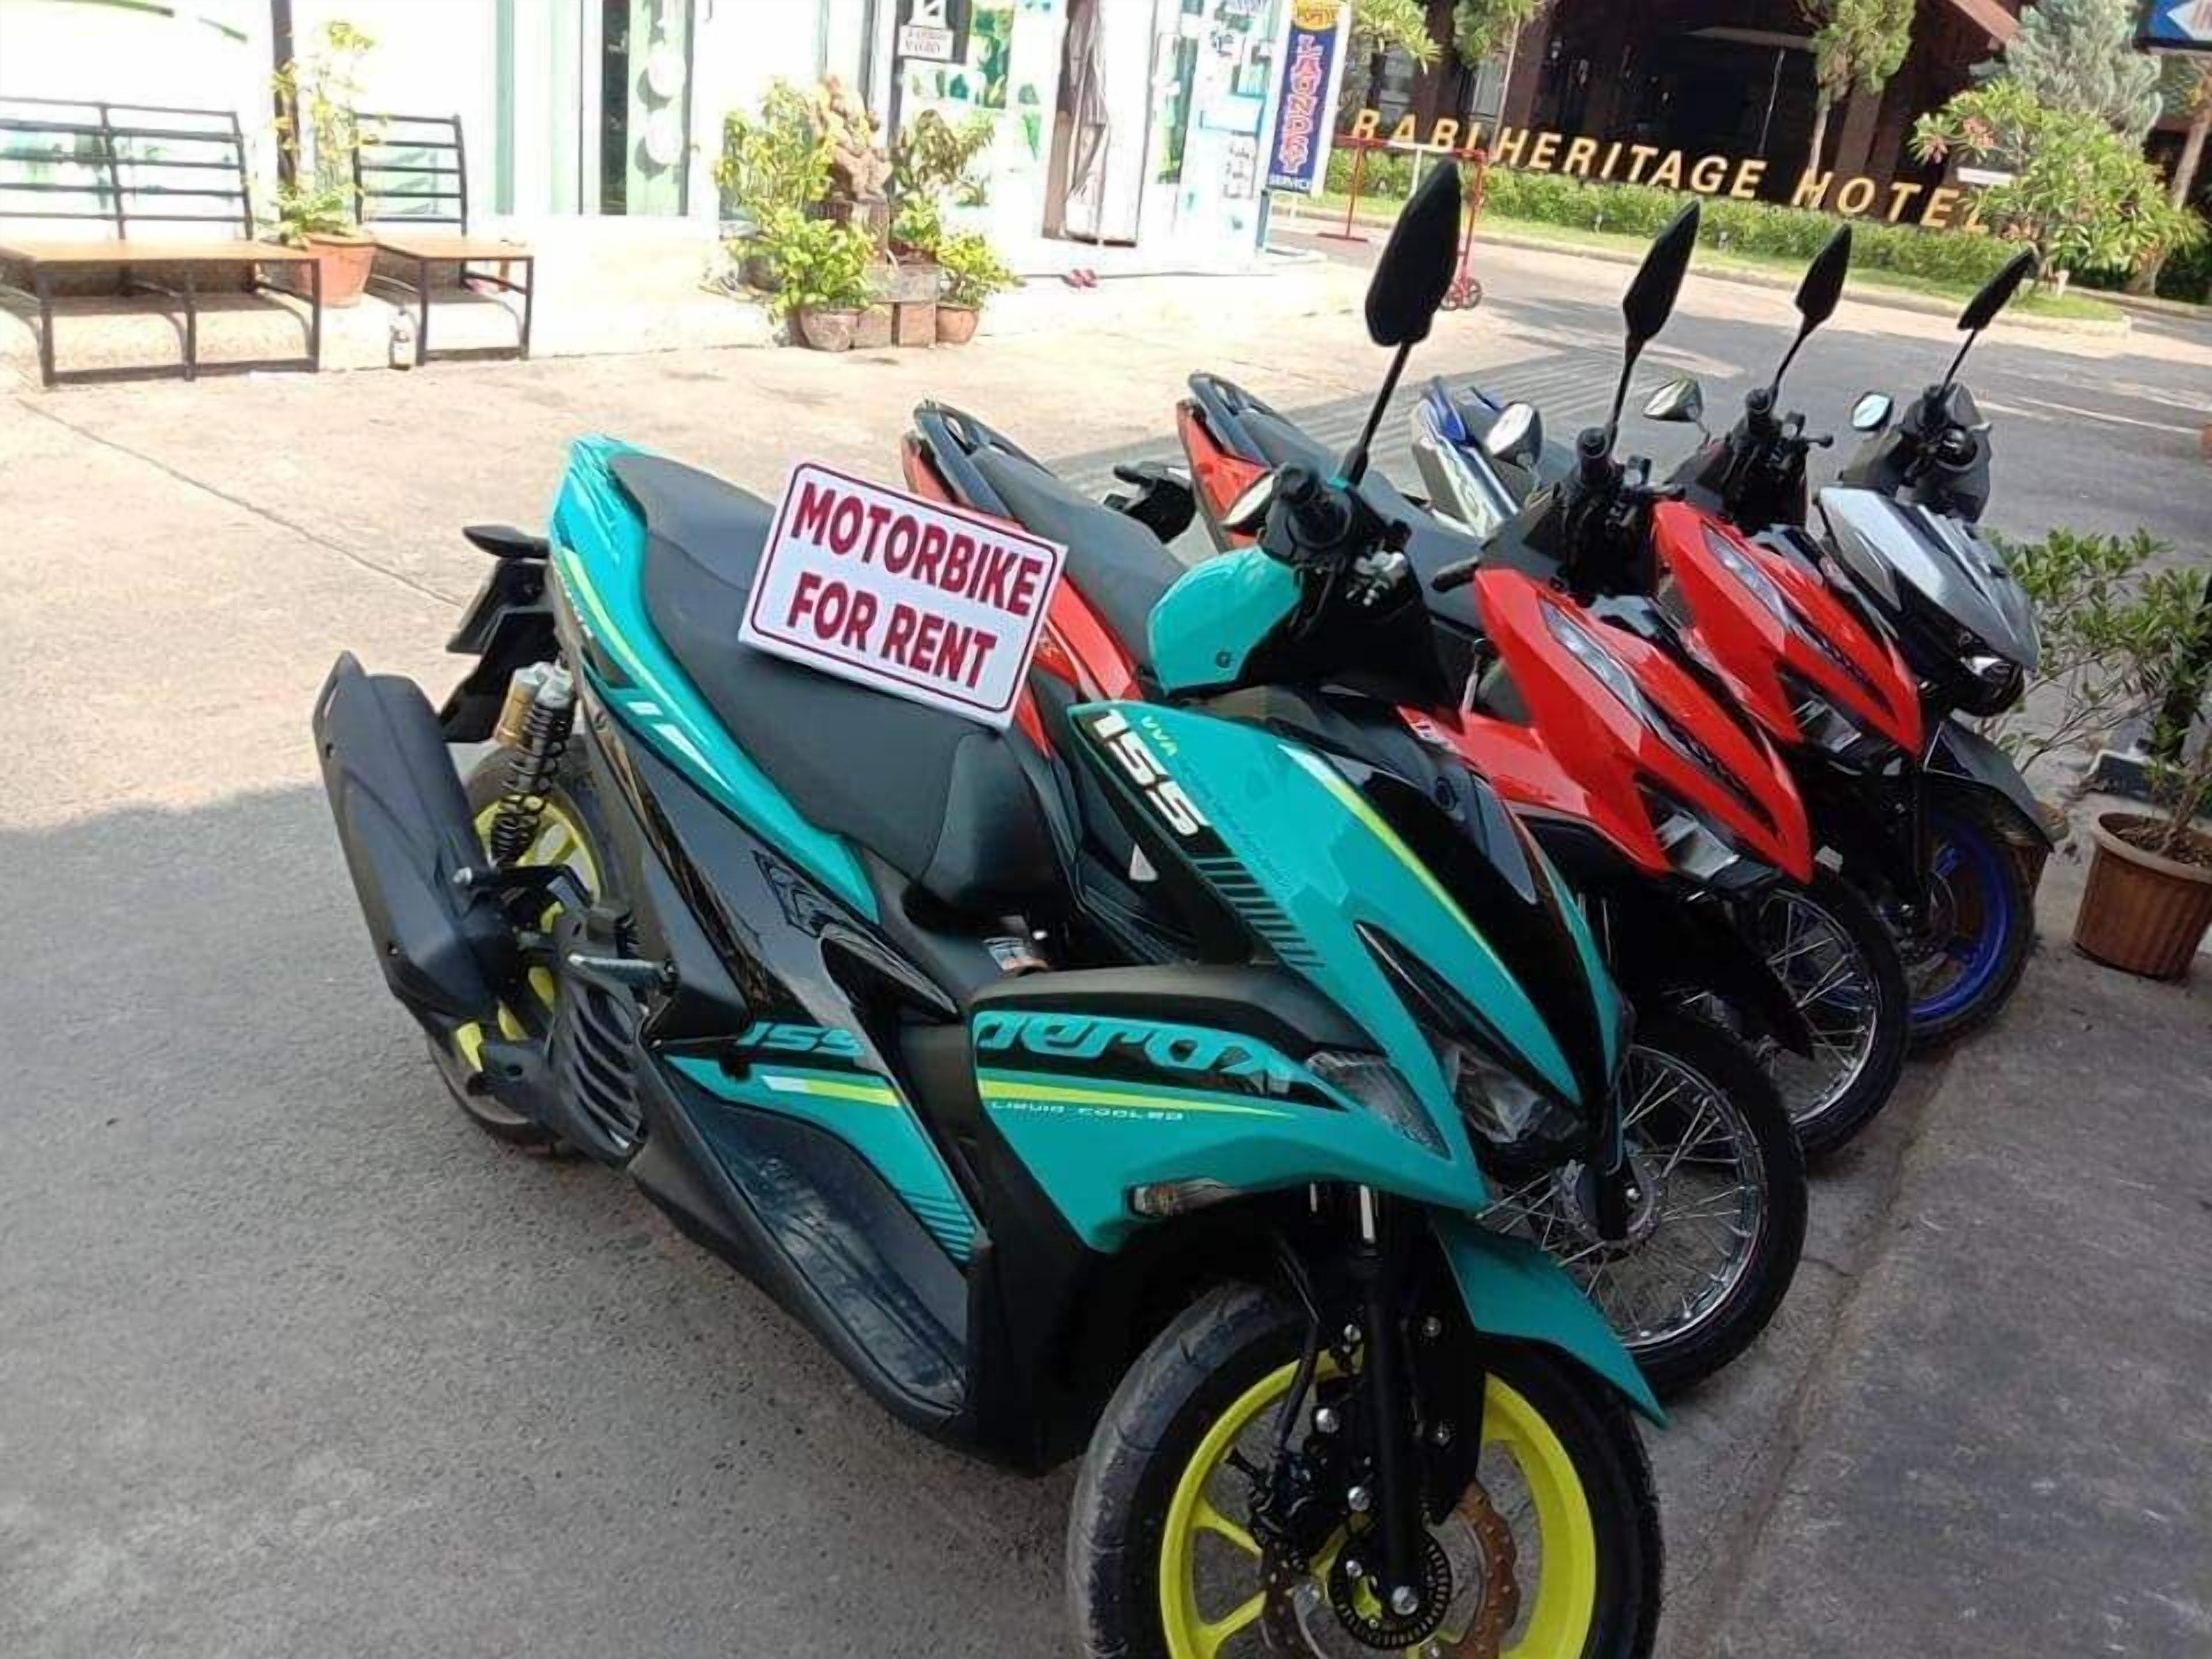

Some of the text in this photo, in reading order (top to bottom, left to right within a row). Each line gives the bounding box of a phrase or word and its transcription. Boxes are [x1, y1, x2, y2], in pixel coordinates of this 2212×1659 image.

[1494, 126, 1768, 200] HERITAGE
[790, 482, 1043, 616] MOTORBIKE
[786, 571, 998, 689] FOR RENT
[1094, 709, 1210, 836] 155
[738, 1021, 861, 1058] 155
[1078, 1107, 1183, 1121] COOLED
